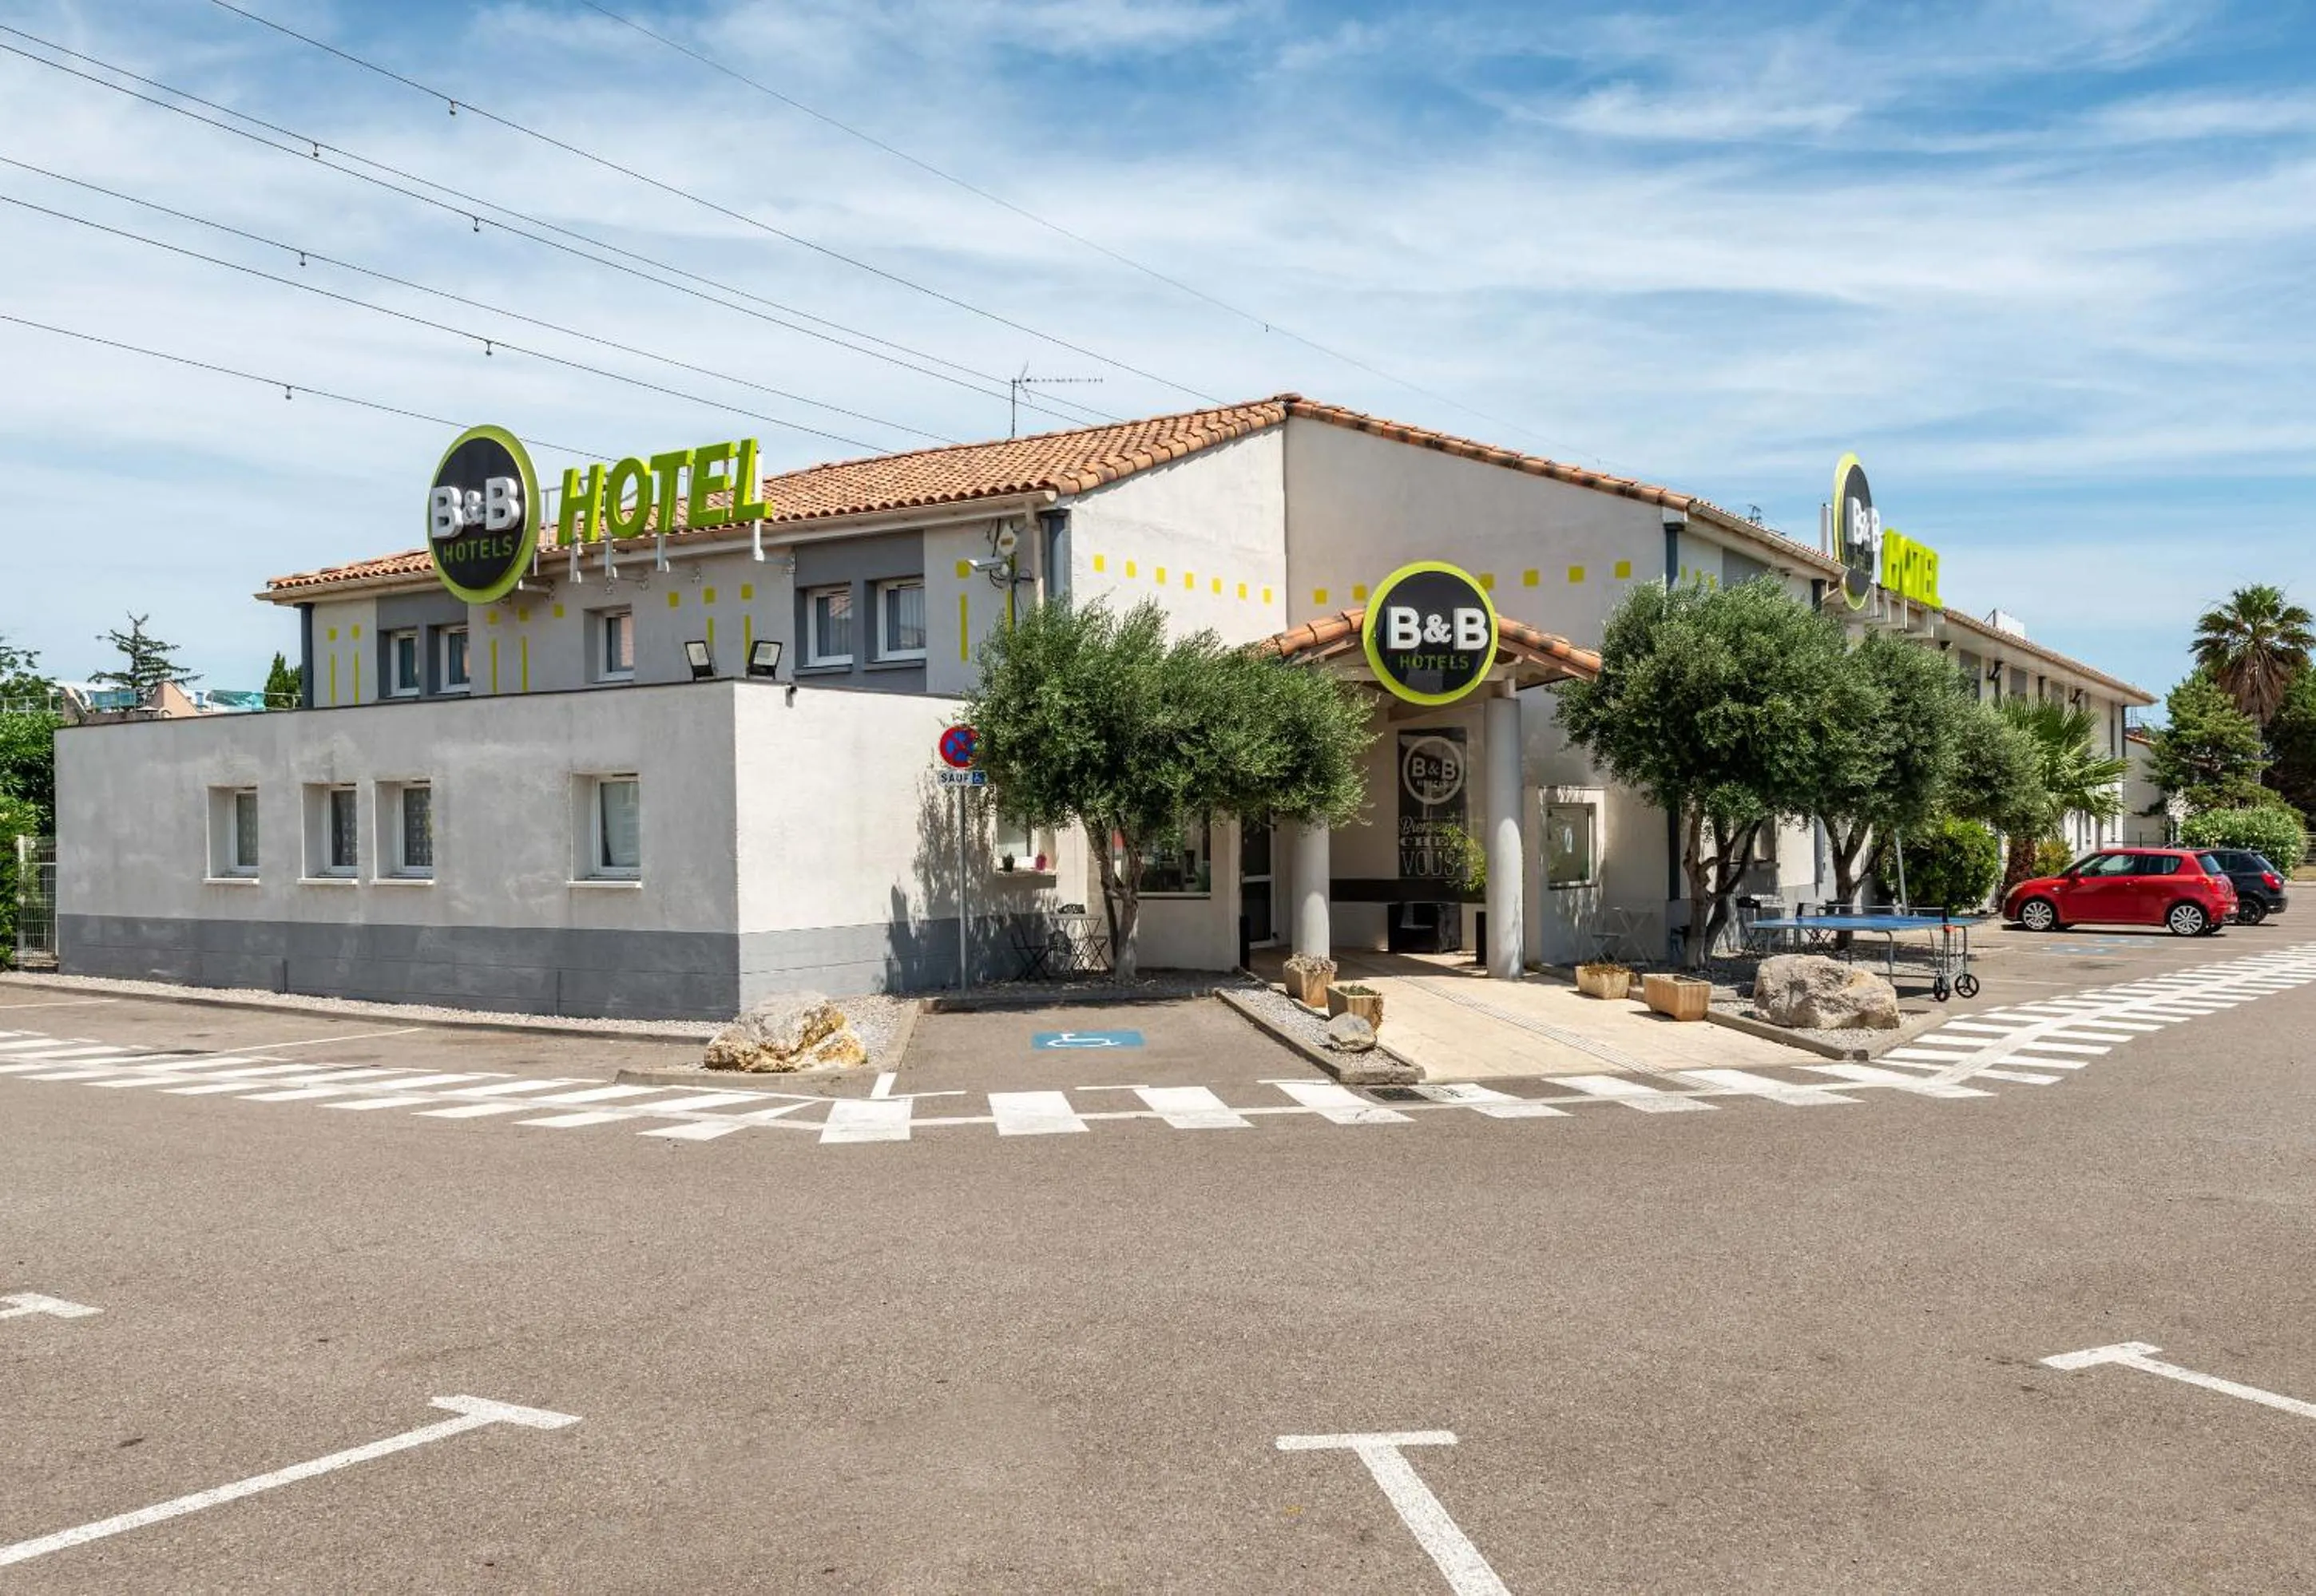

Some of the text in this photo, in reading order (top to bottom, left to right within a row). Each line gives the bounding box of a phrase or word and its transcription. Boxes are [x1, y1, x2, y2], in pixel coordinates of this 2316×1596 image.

[430, 477, 521, 540] B&B
[559, 438, 772, 546] HOTEL
[442, 536, 513, 564] HOTELS
[1386, 606, 1489, 650] B&B
[1399, 655, 1469, 669] HOTELS
[1412, 757, 1456, 780] B&B
